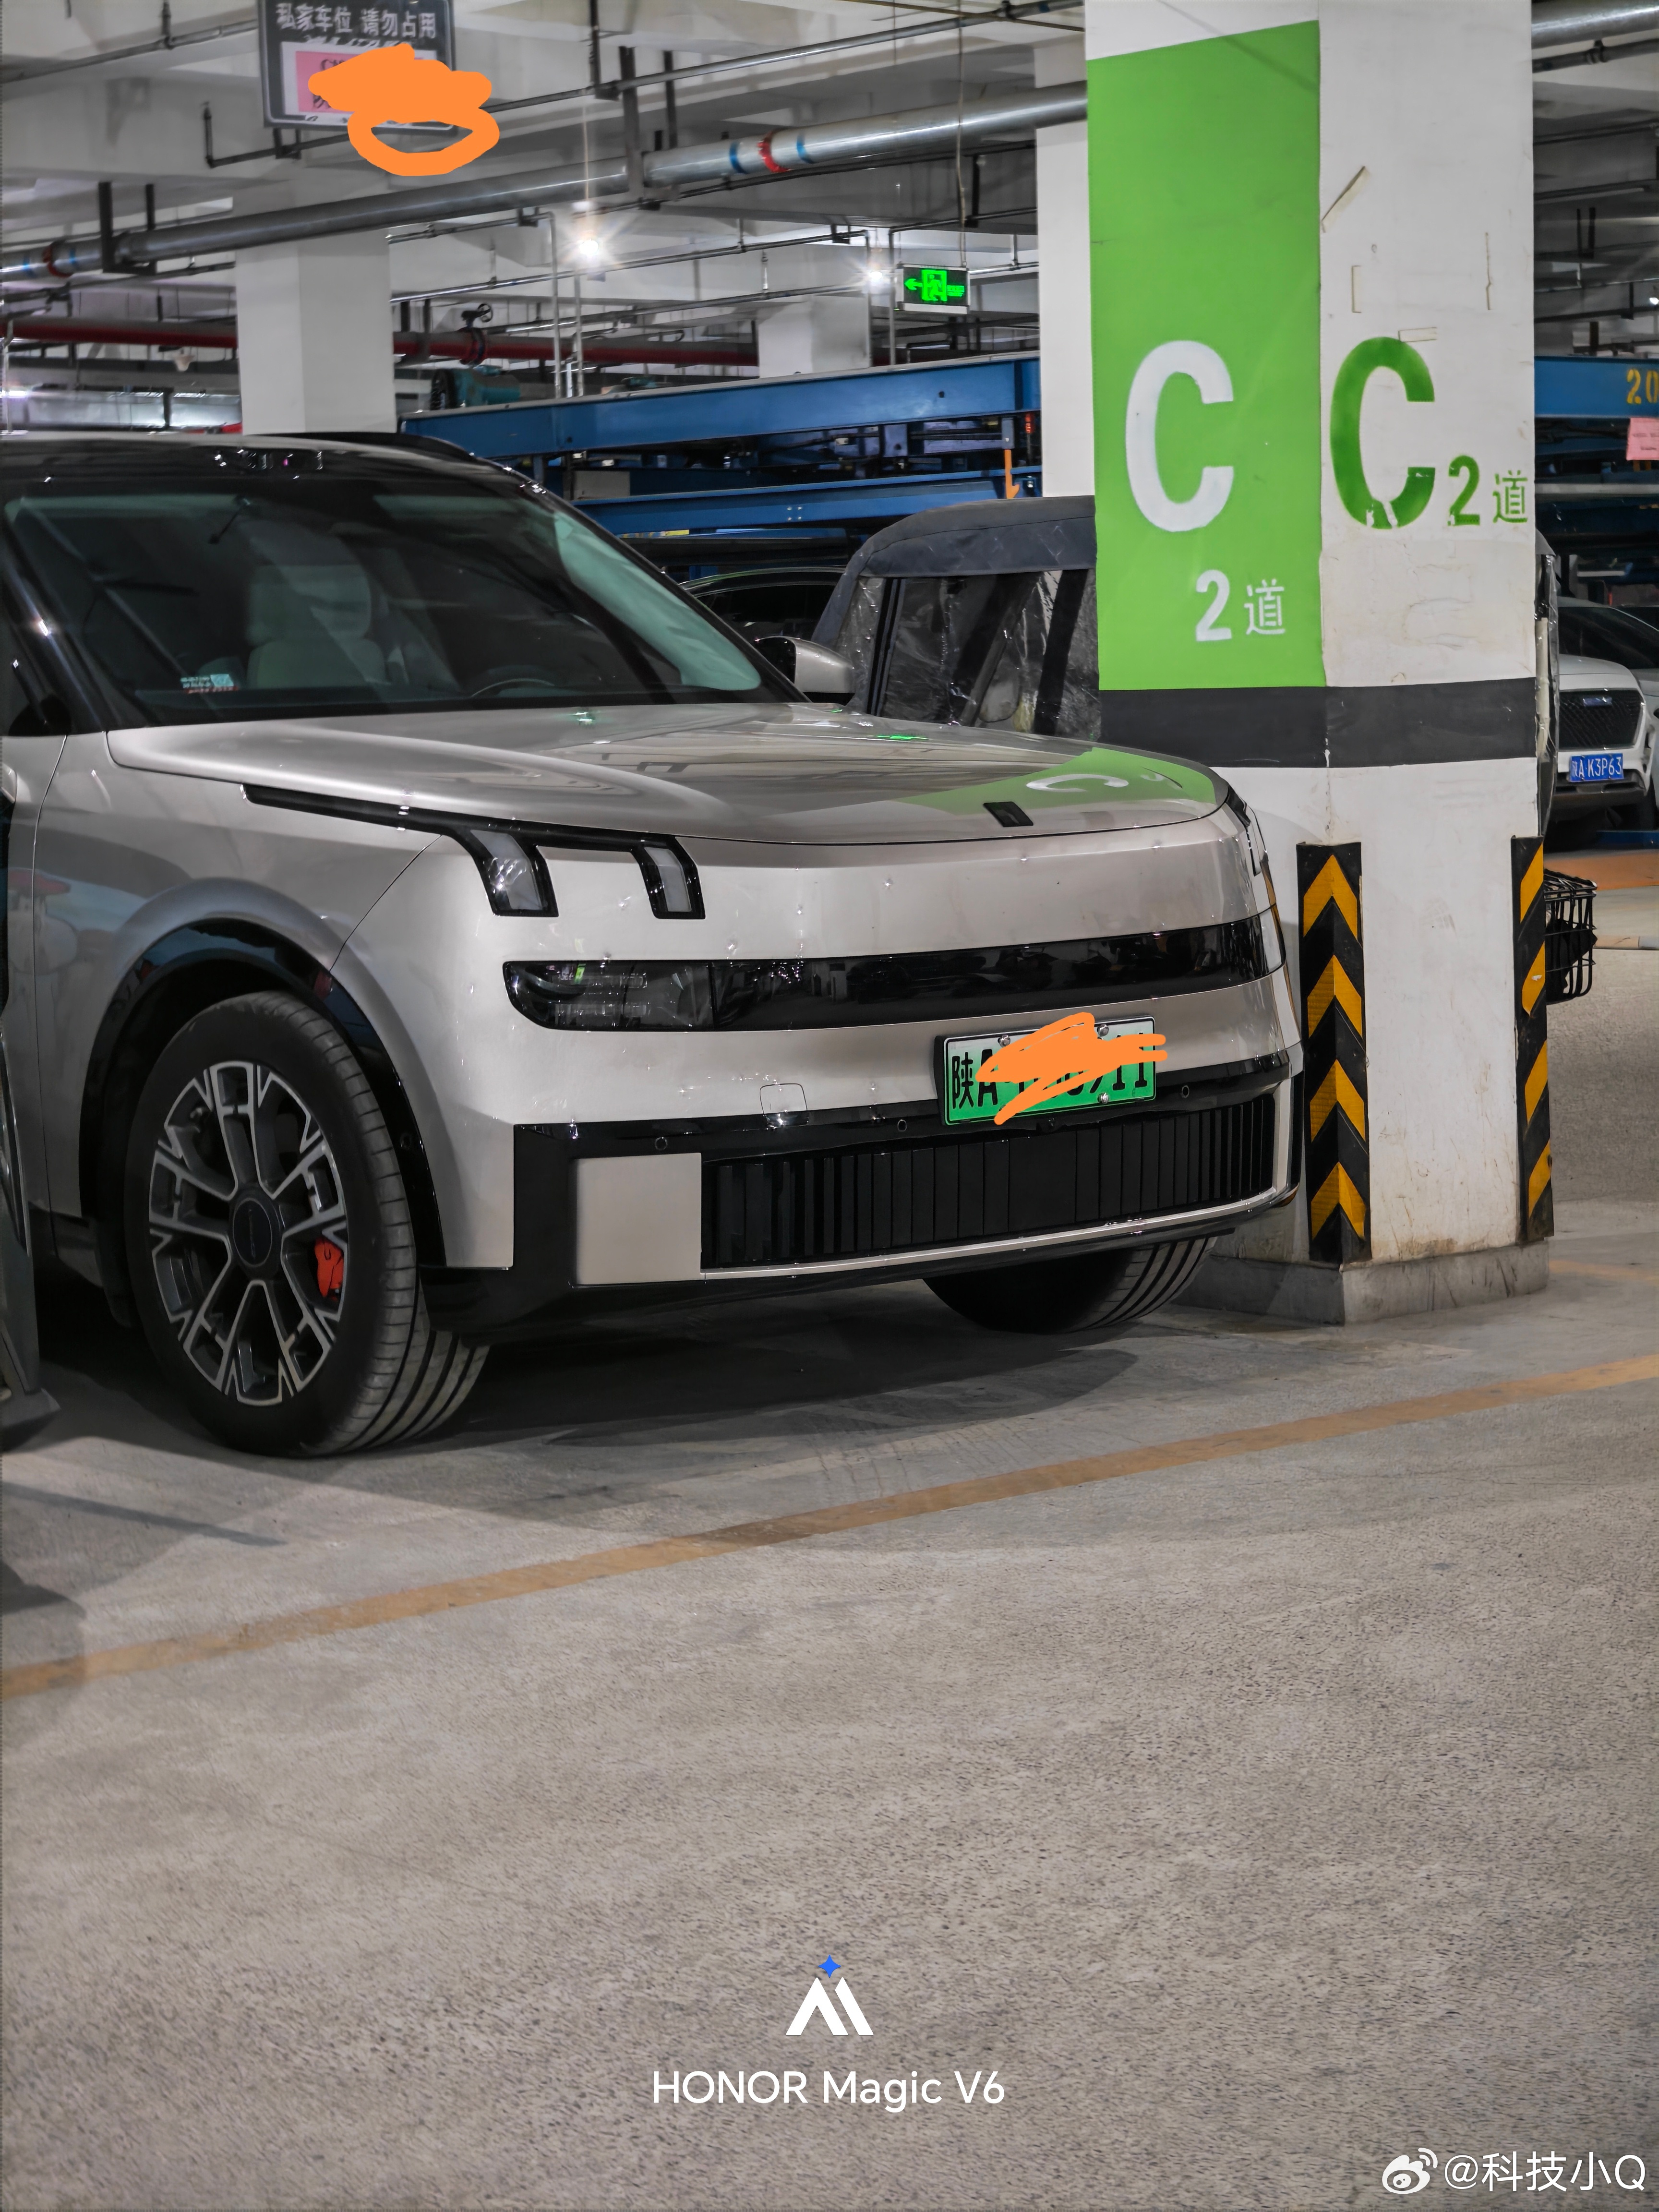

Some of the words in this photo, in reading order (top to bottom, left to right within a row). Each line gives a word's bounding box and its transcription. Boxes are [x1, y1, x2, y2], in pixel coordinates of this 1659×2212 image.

[276, 2, 352, 34] 私家车位
[360, 7, 436, 39] 请勿占用
[1125, 340, 1234, 532] C
[1329, 337, 1436, 530] C
[1195, 569, 1286, 642] 2道
